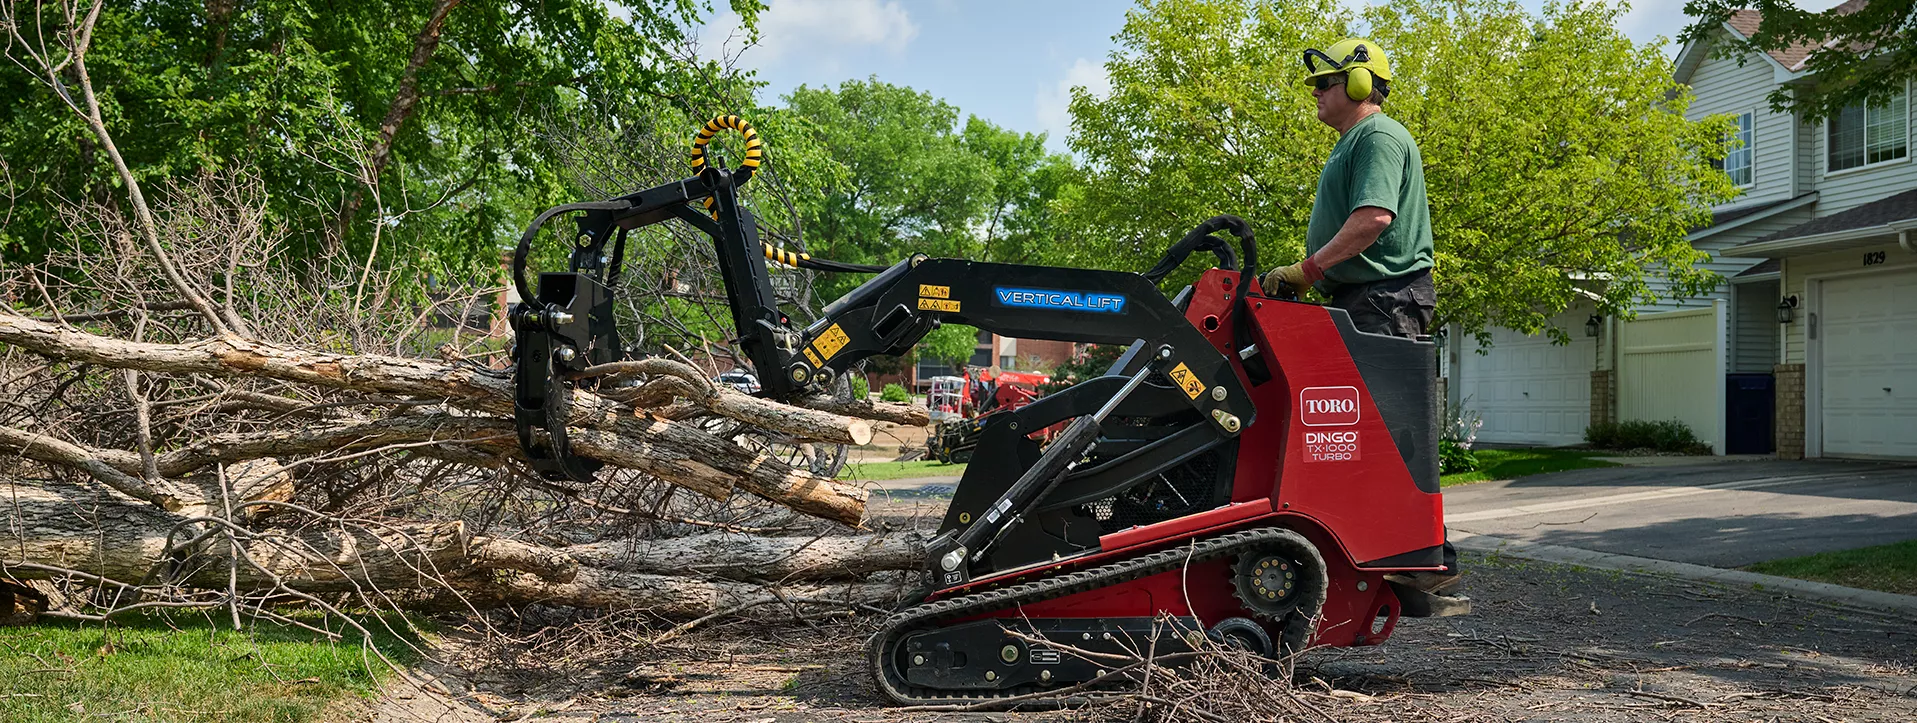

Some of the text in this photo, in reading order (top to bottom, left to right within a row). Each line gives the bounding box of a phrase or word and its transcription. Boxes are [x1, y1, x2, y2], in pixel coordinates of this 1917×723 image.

[1863, 251, 1886, 266] 1829
[1000, 291, 1122, 309] VERTICAL LIFT
[1306, 432, 1357, 444] DINGO
[1312, 452, 1352, 461] TURBO
